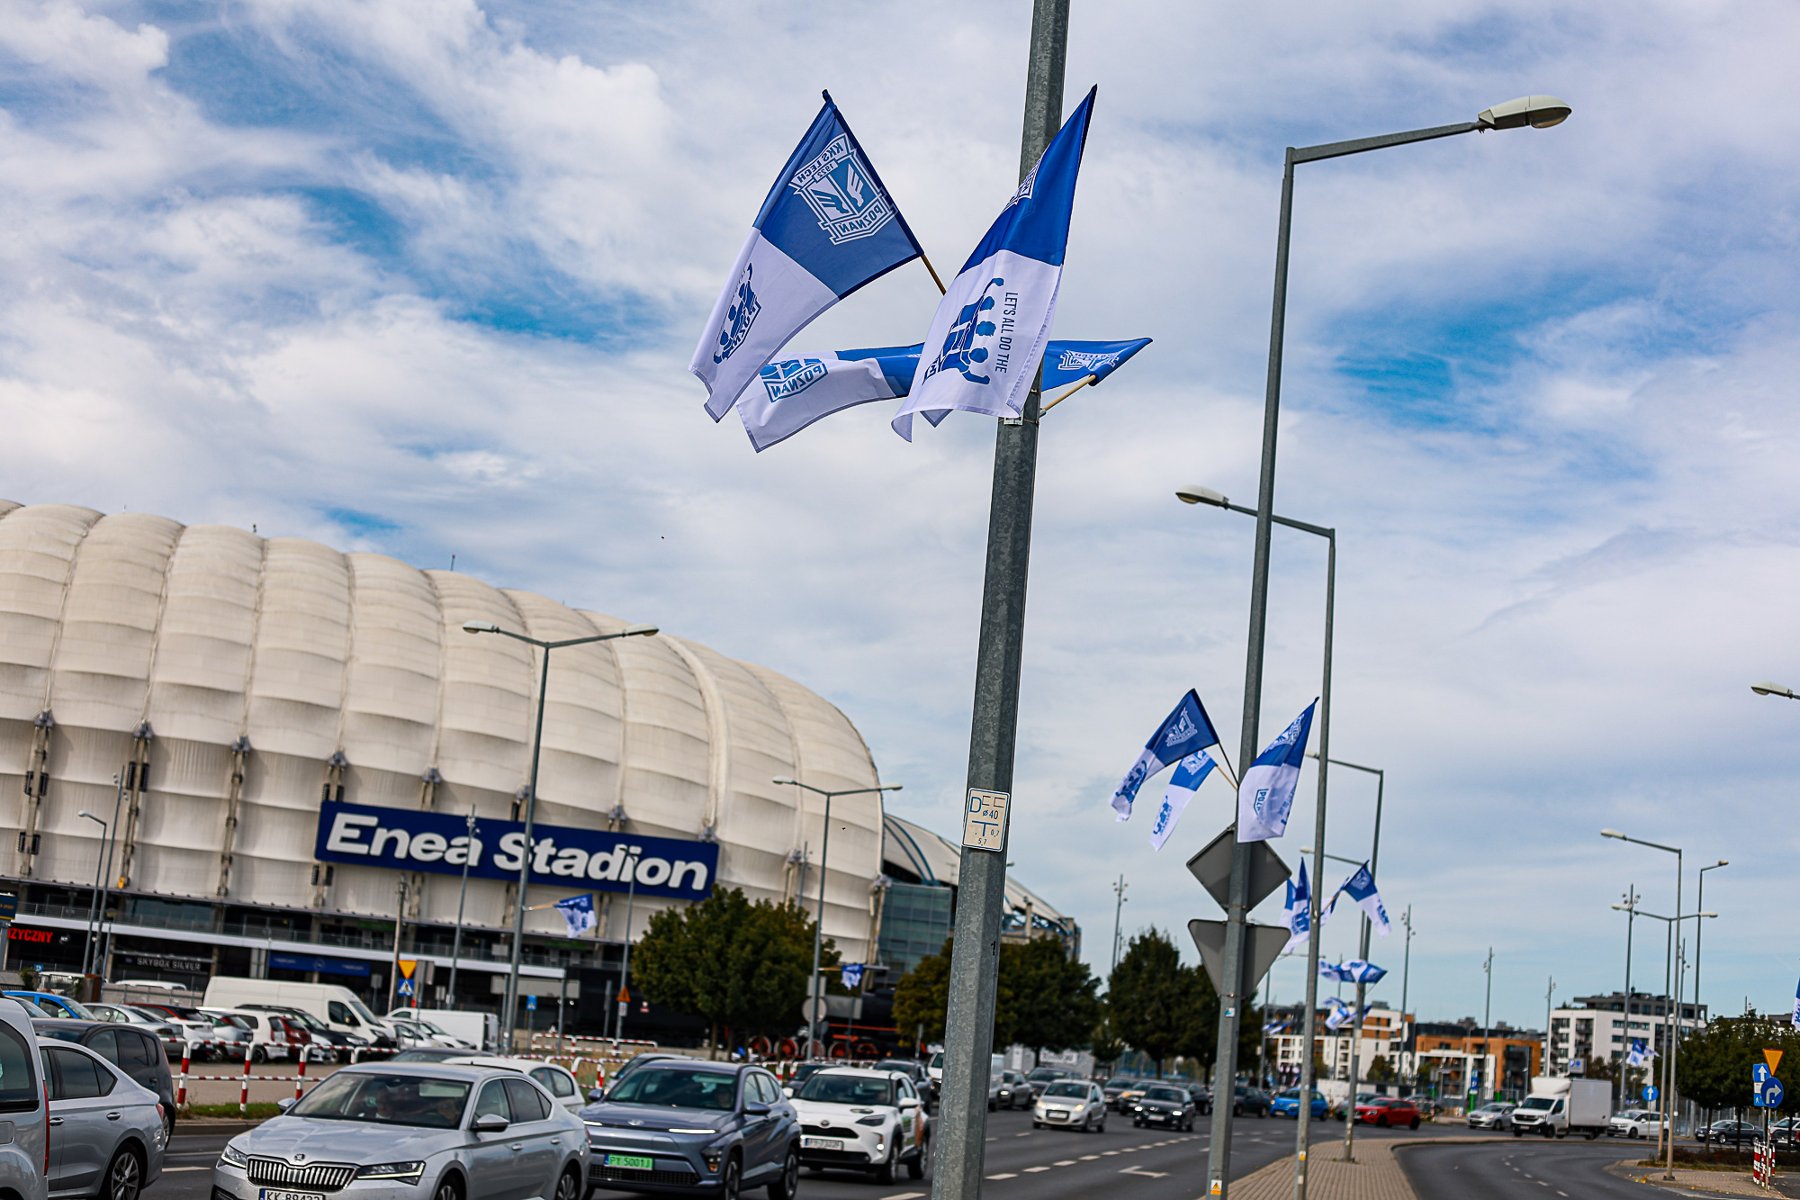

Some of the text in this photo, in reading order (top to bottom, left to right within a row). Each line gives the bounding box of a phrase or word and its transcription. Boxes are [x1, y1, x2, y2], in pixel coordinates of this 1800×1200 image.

[995, 292, 1018, 374] LET'S ALL DO THE
[326, 812, 709, 891] Enea Stadion
